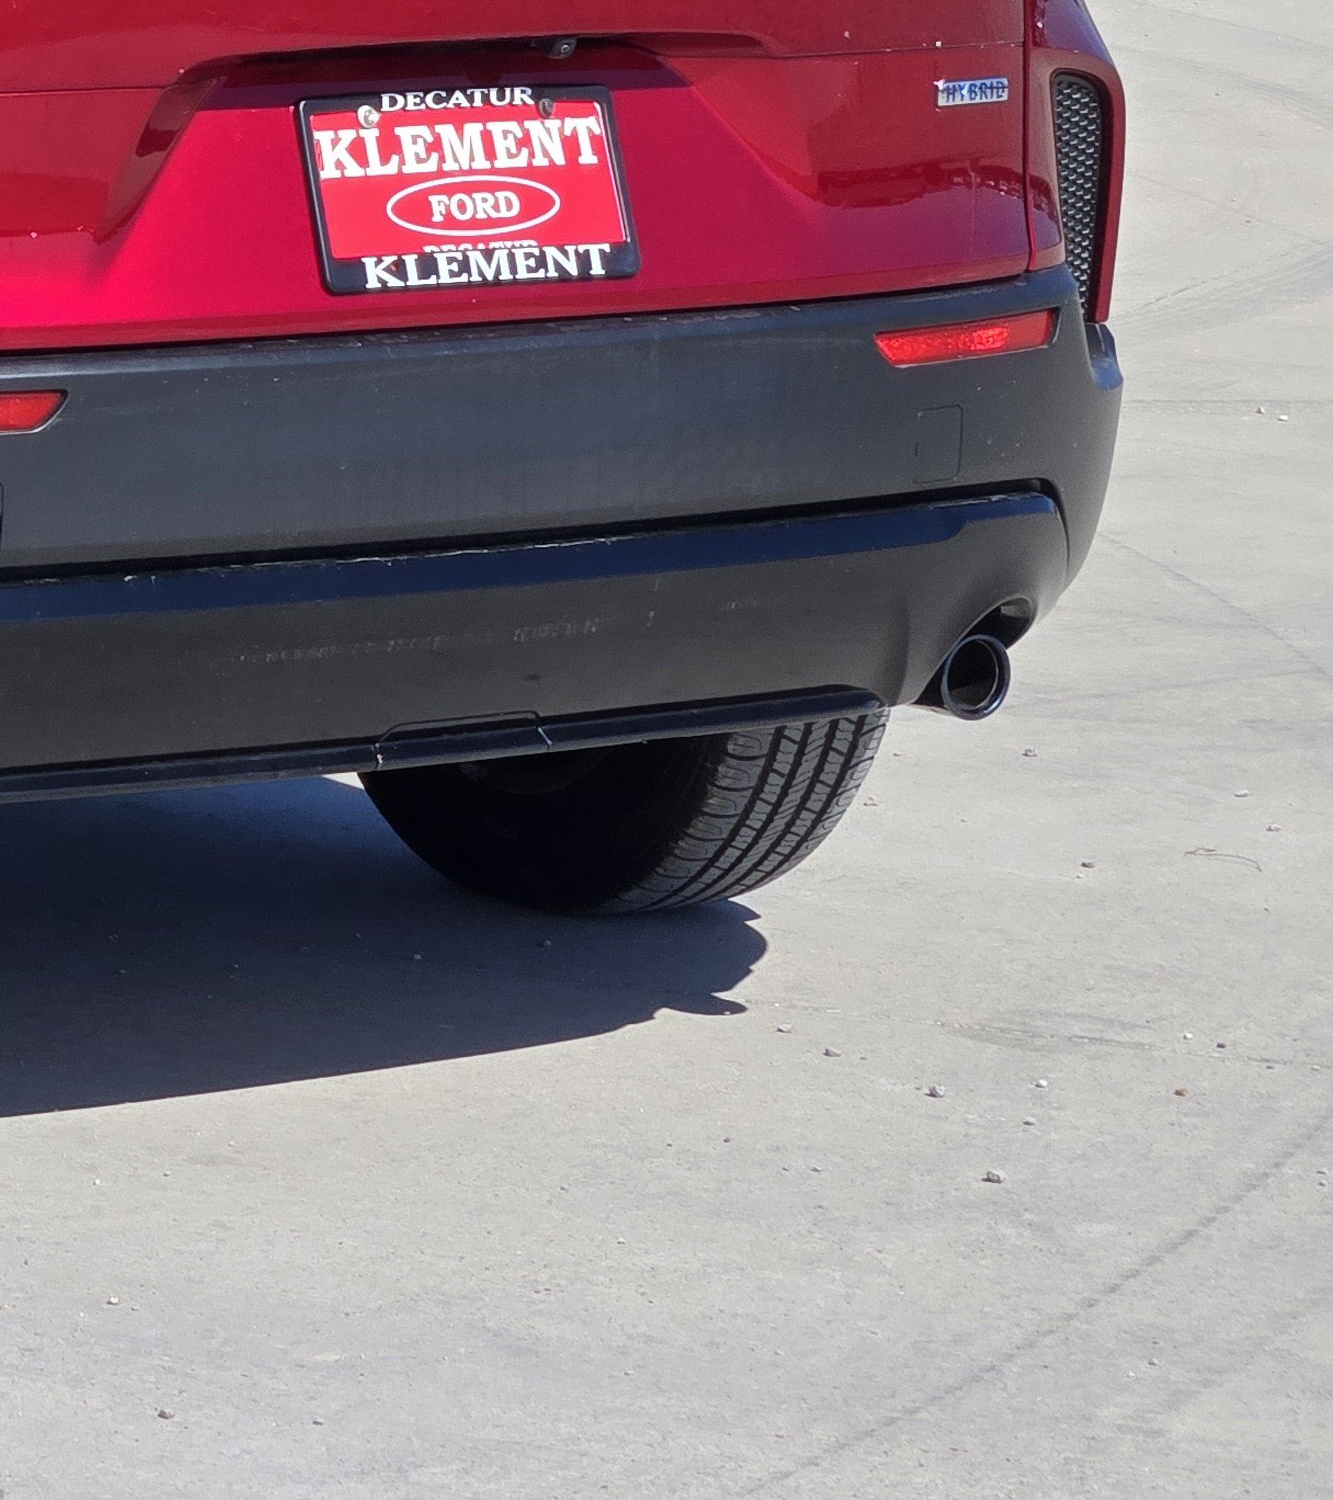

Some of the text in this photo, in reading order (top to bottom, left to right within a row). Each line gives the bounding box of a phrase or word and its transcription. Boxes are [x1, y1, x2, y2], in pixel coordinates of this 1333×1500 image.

[380, 87, 536, 113] DECATUR
[945, 80, 1005, 103] HYBRID
[314, 116, 602, 180] KLEMENT
[428, 191, 521, 223] FORD
[361, 243, 611, 289] KLEMENT
